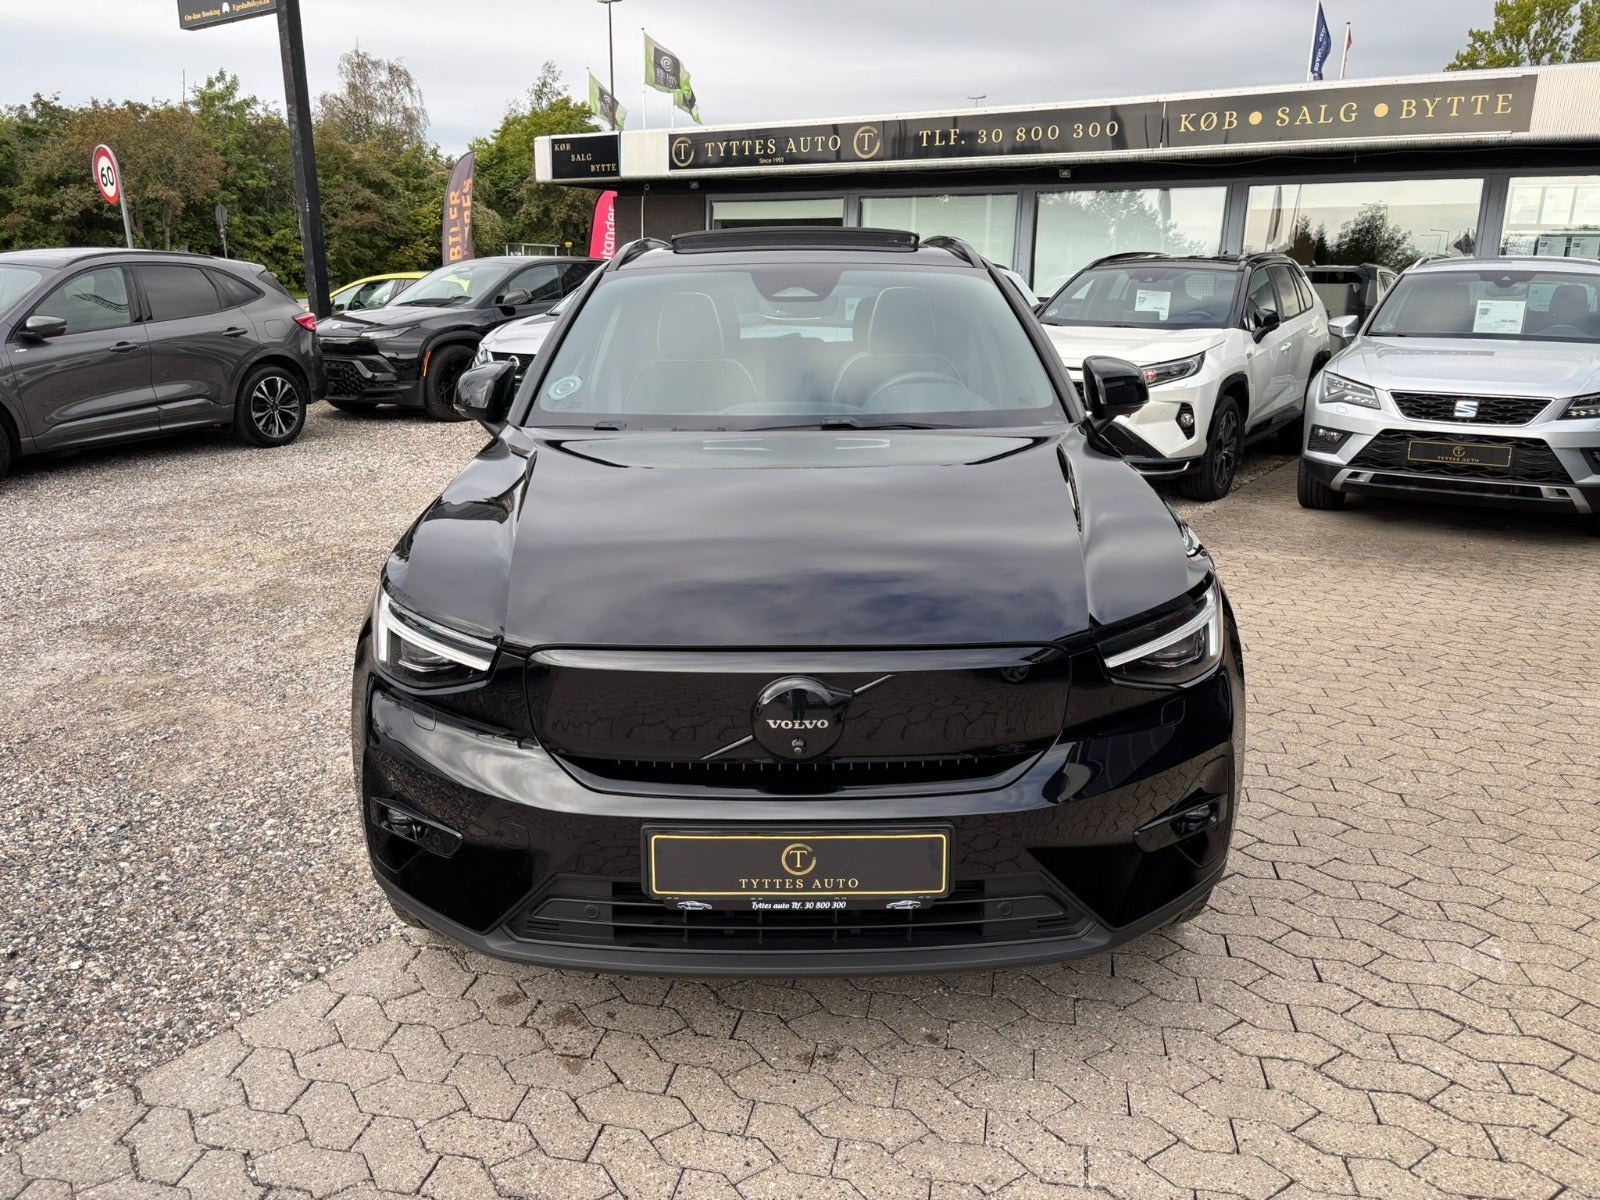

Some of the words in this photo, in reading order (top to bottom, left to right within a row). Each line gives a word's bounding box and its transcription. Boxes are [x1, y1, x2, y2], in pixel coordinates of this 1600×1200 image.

[1179, 110, 1238, 132] KØB
[1275, 102, 1358, 127] SALG
[1400, 93, 1514, 119] BYTTE
[919, 128, 965, 146] TLF.
[977, 128, 1003, 144] 30
[1015, 125, 1060, 142] 800
[1073, 121, 1119, 139] 300
[554, 143, 571, 151] KØB
[705, 138, 776, 157] TYTTES
[785, 134, 841, 153] AUTO
[570, 153, 592, 162] SALG
[590, 163, 617, 172] BYTTE
[100, 166, 115, 187] 60
[448, 190, 462, 261] BILER
[766, 719, 829, 730] VOLVO
[739, 878, 804, 889] TYTTES
[812, 878, 859, 889] AUTO
[751, 901, 771, 910] Tyttes
[804, 901, 814, 909] 30
[815, 901, 831, 909] 800
[832, 901, 847, 909] 300
